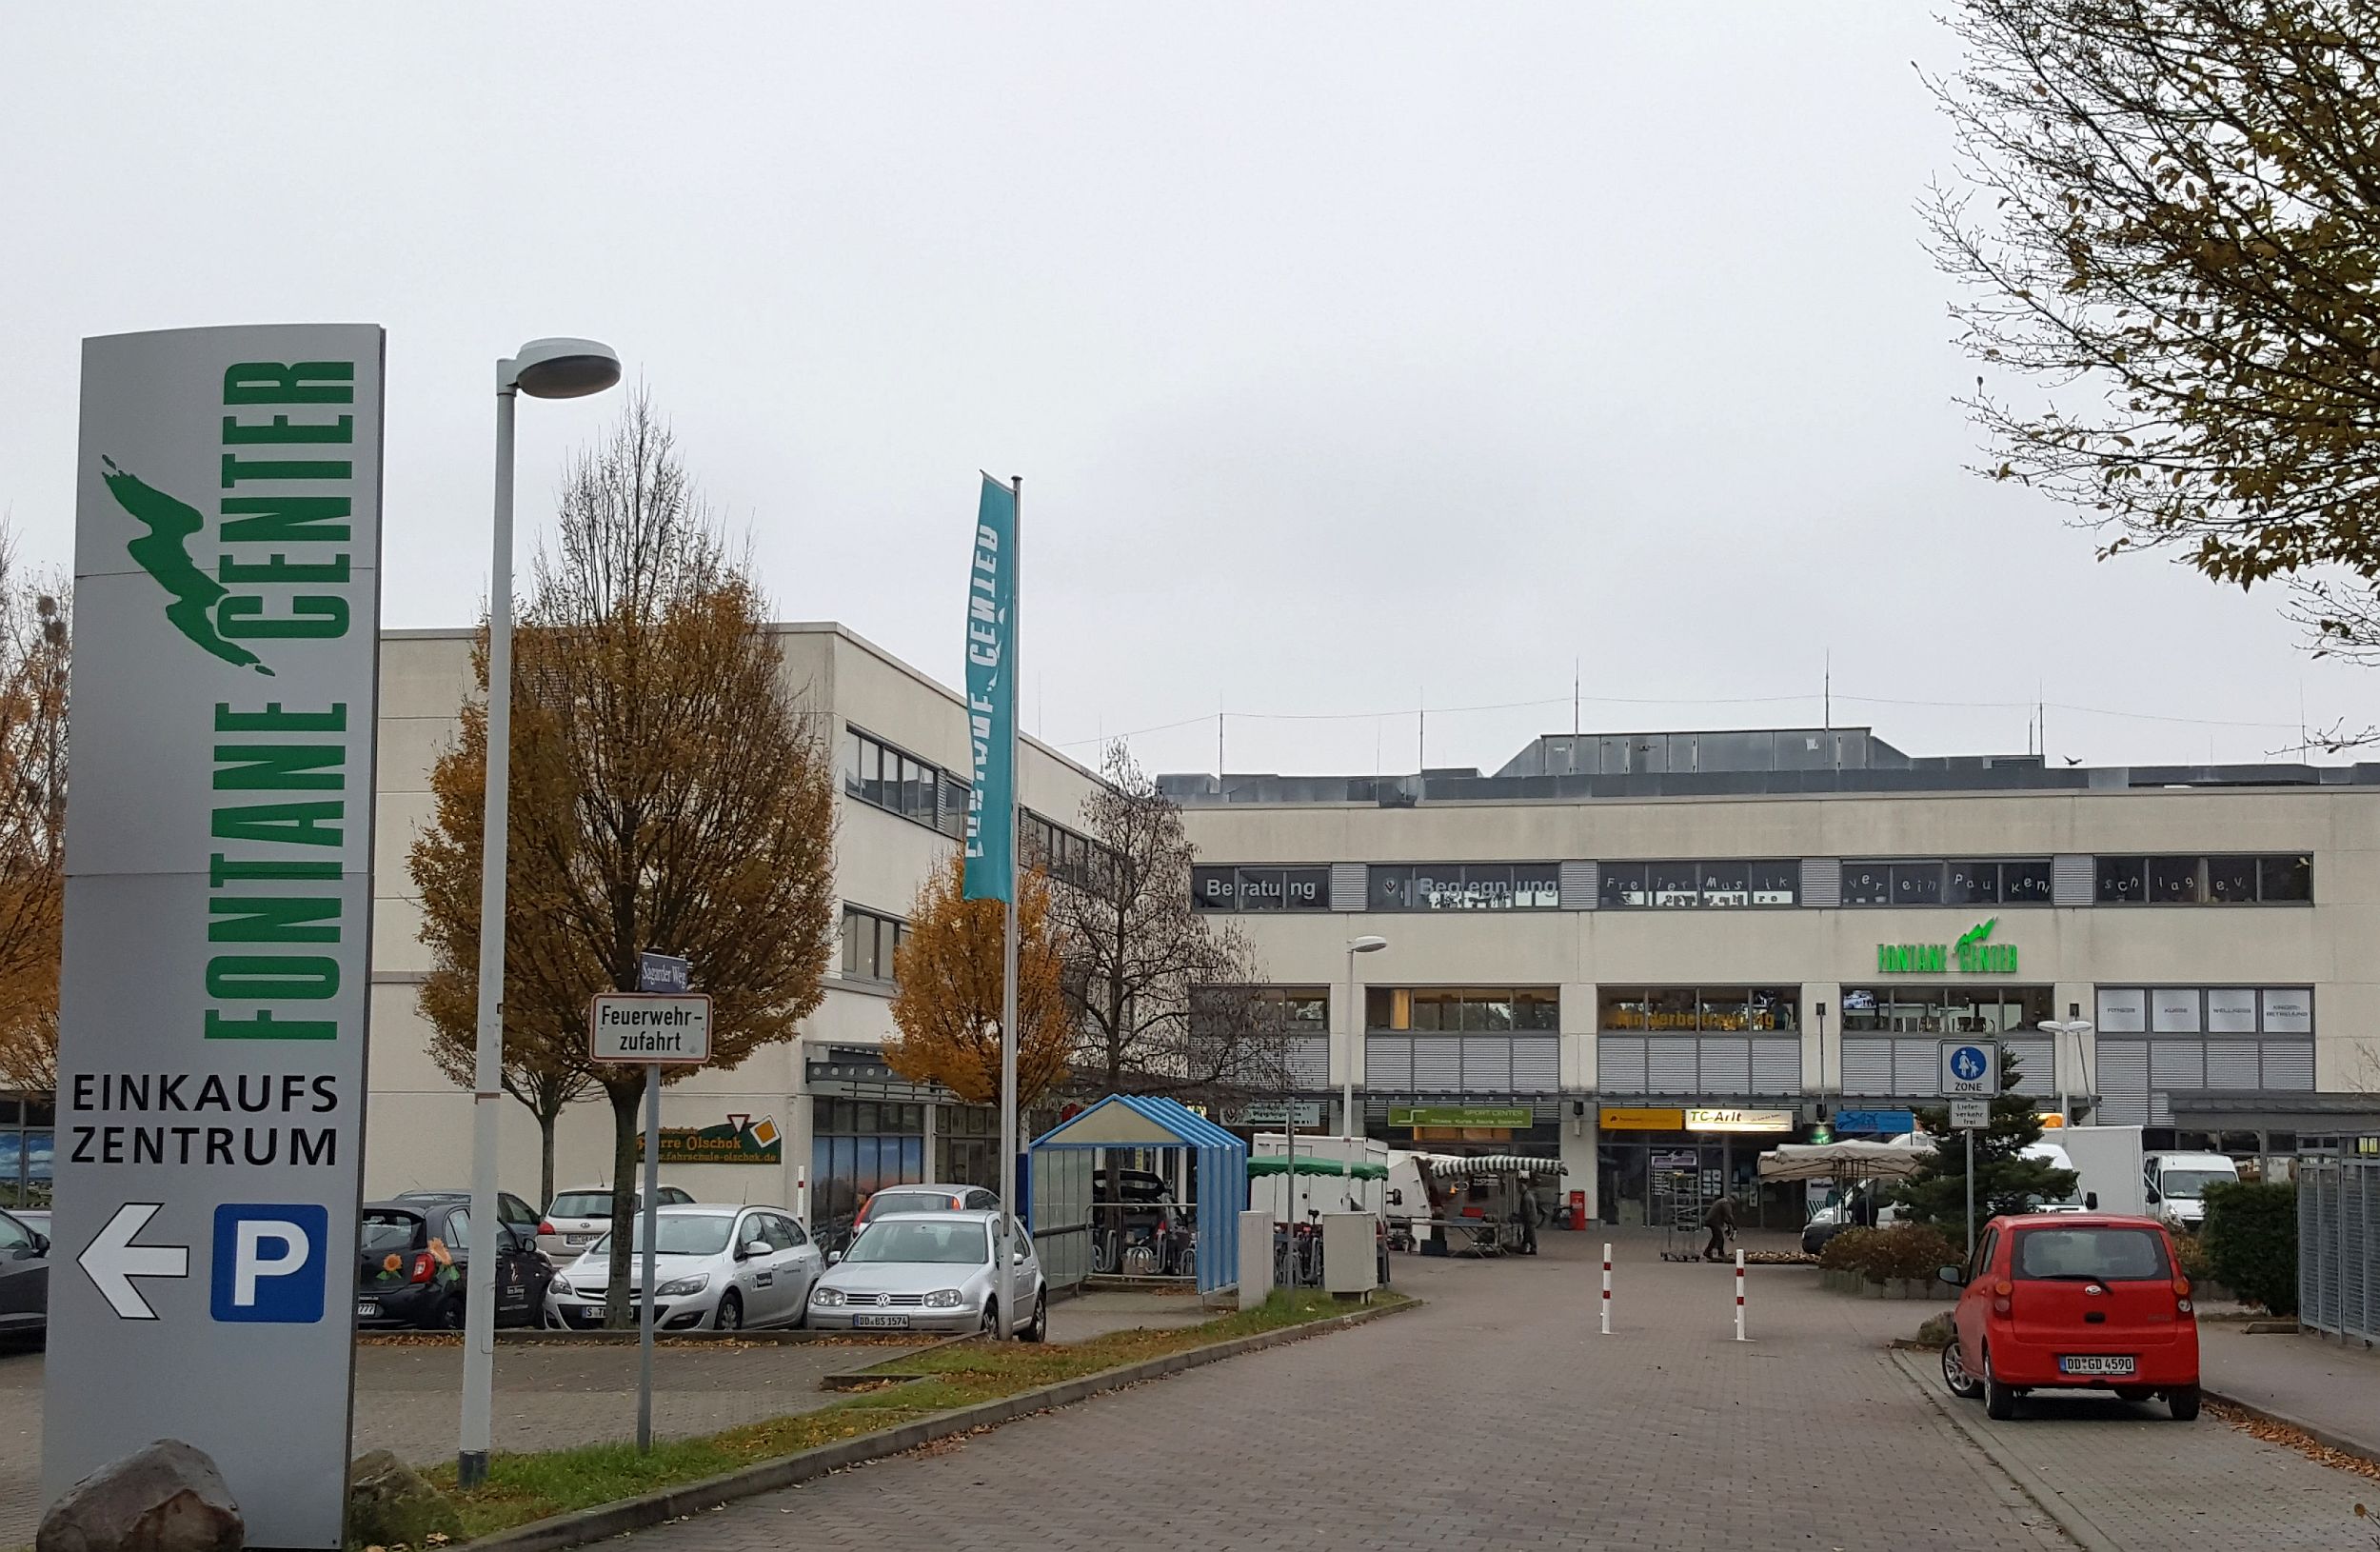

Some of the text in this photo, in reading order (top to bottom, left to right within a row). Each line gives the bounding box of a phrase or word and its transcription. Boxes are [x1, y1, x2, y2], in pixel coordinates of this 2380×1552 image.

[205, 362, 354, 1039] FONTANE CENTER
[1206, 879, 1316, 900] Beratung
[1877, 943, 2018, 972] FONTANE CENTER
[672, 965, 686, 988] Weg
[602, 1005, 703, 1026] Feuerwehr-
[620, 1031, 682, 1051] zufahrt
[73, 1074, 339, 1112] EINKAUFS
[1954, 1083, 1983, 1091] ZONE
[70, 1126, 337, 1166] ZENTRUM
[636, 1136, 742, 1151] Prre Olschok
[234, 1220, 309, 1306] P
[2105, 1357, 2132, 1369] 4590
